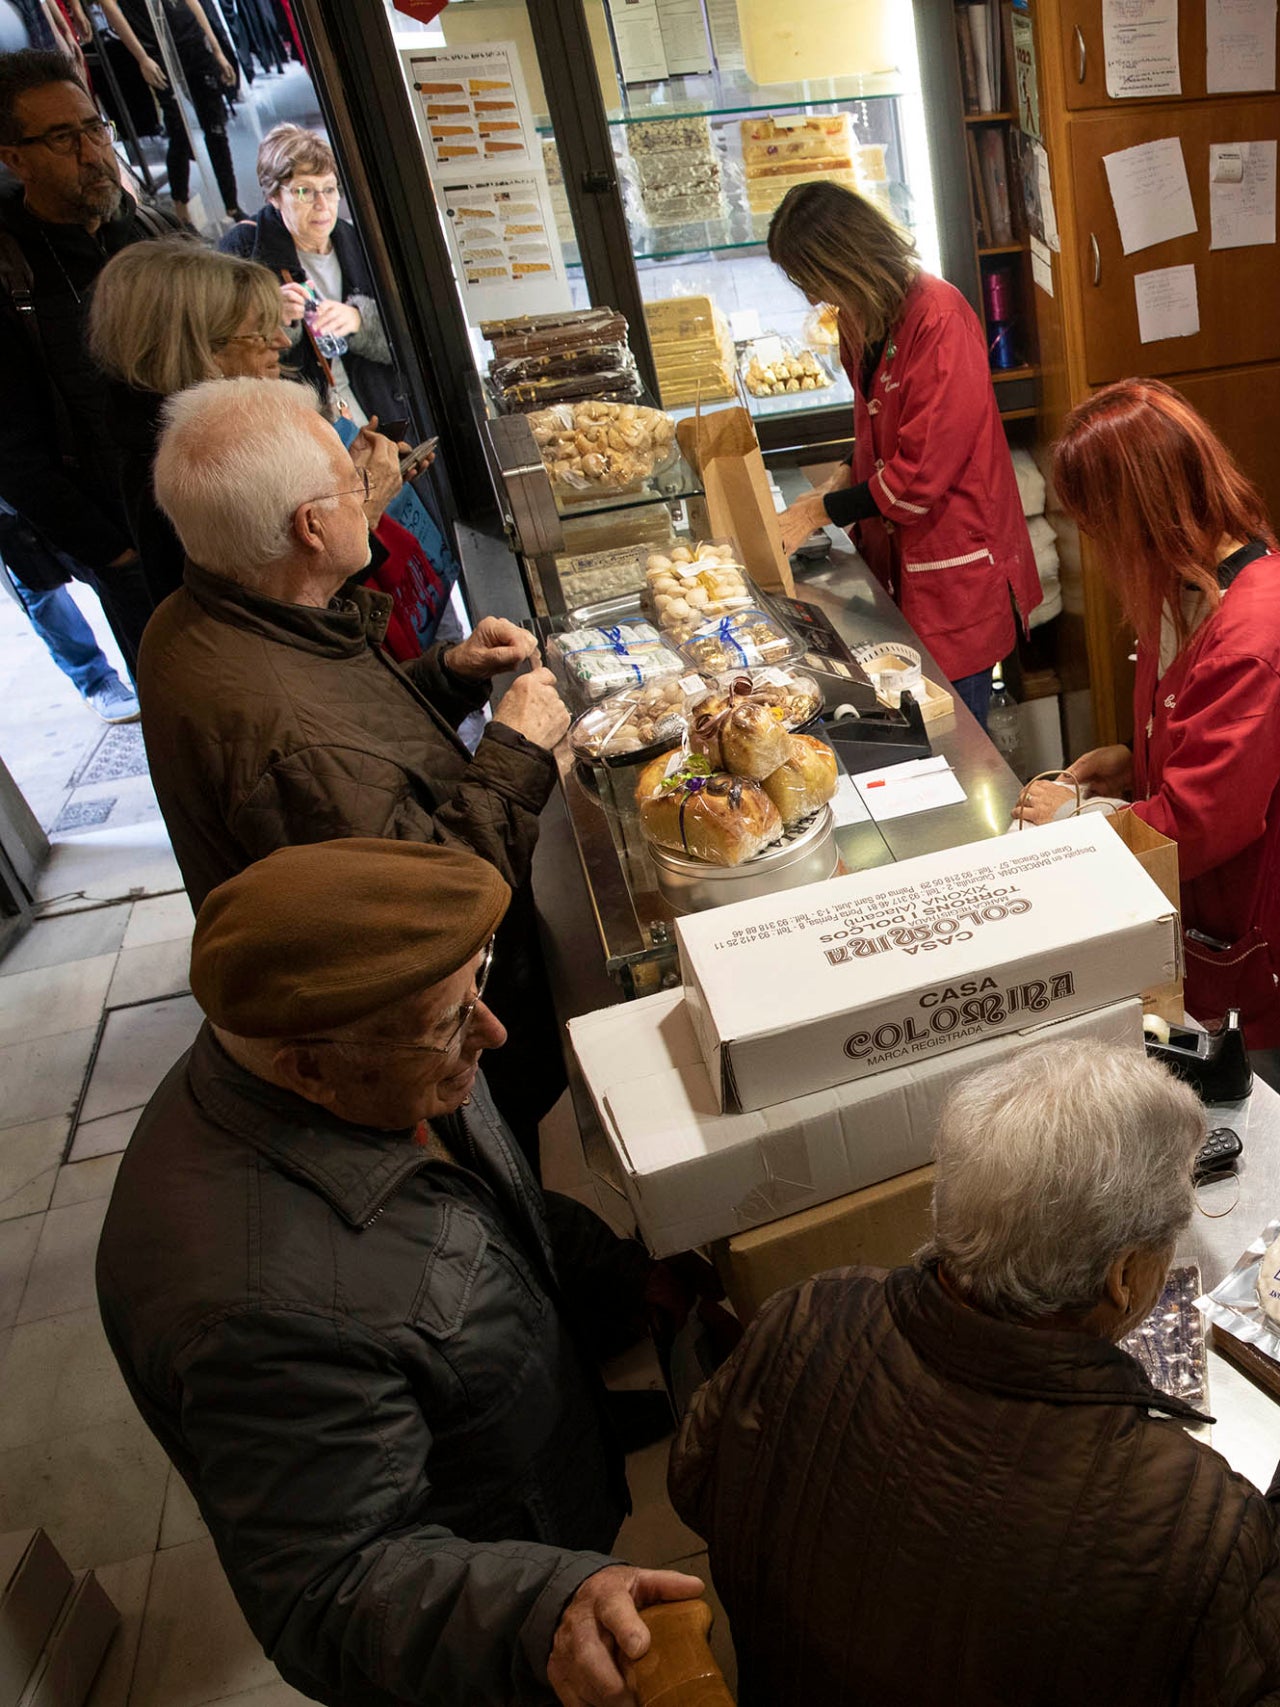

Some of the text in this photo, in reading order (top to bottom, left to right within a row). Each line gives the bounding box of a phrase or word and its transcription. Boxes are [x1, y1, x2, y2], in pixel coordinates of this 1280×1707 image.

[1039, 850, 1050, 858] de
[1050, 843, 1072, 856] Gran
[1062, 844, 1095, 860] Despatx
[1008, 852, 1038, 867] Gracia,
[1051, 854, 1062, 862] en
[997, 857, 1051, 877] BARCELONA
[998, 860, 1009, 869] 57
[944, 873, 960, 883] 218
[960, 870, 972, 879] 93
[919, 880, 931, 889] 29
[931, 877, 943, 887] 05
[874, 892, 885, 901] de
[887, 884, 914, 898] Palma
[908, 892, 920, 900] 93
[853, 895, 874, 907] Sant
[876, 899, 890, 908] 46
[891, 895, 907, 905] 317
[922, 883, 1020, 916] TORRONS
[831, 900, 853, 913] Just,
[842, 883, 988, 928] XIXONA (Alacant)
[866, 903, 876, 911] 81
[907, 895, 1008, 926] MARCA REGISTRADA
[816, 907, 830, 916] 1-3
[838, 906, 862, 919] Porta
[758, 920, 776, 931] 318
[776, 917, 788, 926] 93
[805, 912, 838, 928] Ferrisa,
[731, 928, 744, 938] 46
[744, 925, 757, 934] 88
[818, 912, 905, 944] DOLÇOS
[825, 898, 1032, 966] COLOMINA
[738, 933, 756, 945] 412
[757, 930, 770, 940] 93
[712, 940, 724, 950] 11
[725, 938, 738, 947] 25
[902, 930, 974, 956] CASA
[919, 976, 998, 1008] CASA
[843, 972, 1074, 1060] COLOMINA
[866, 1023, 984, 1066] MARCA REGISTRADA
